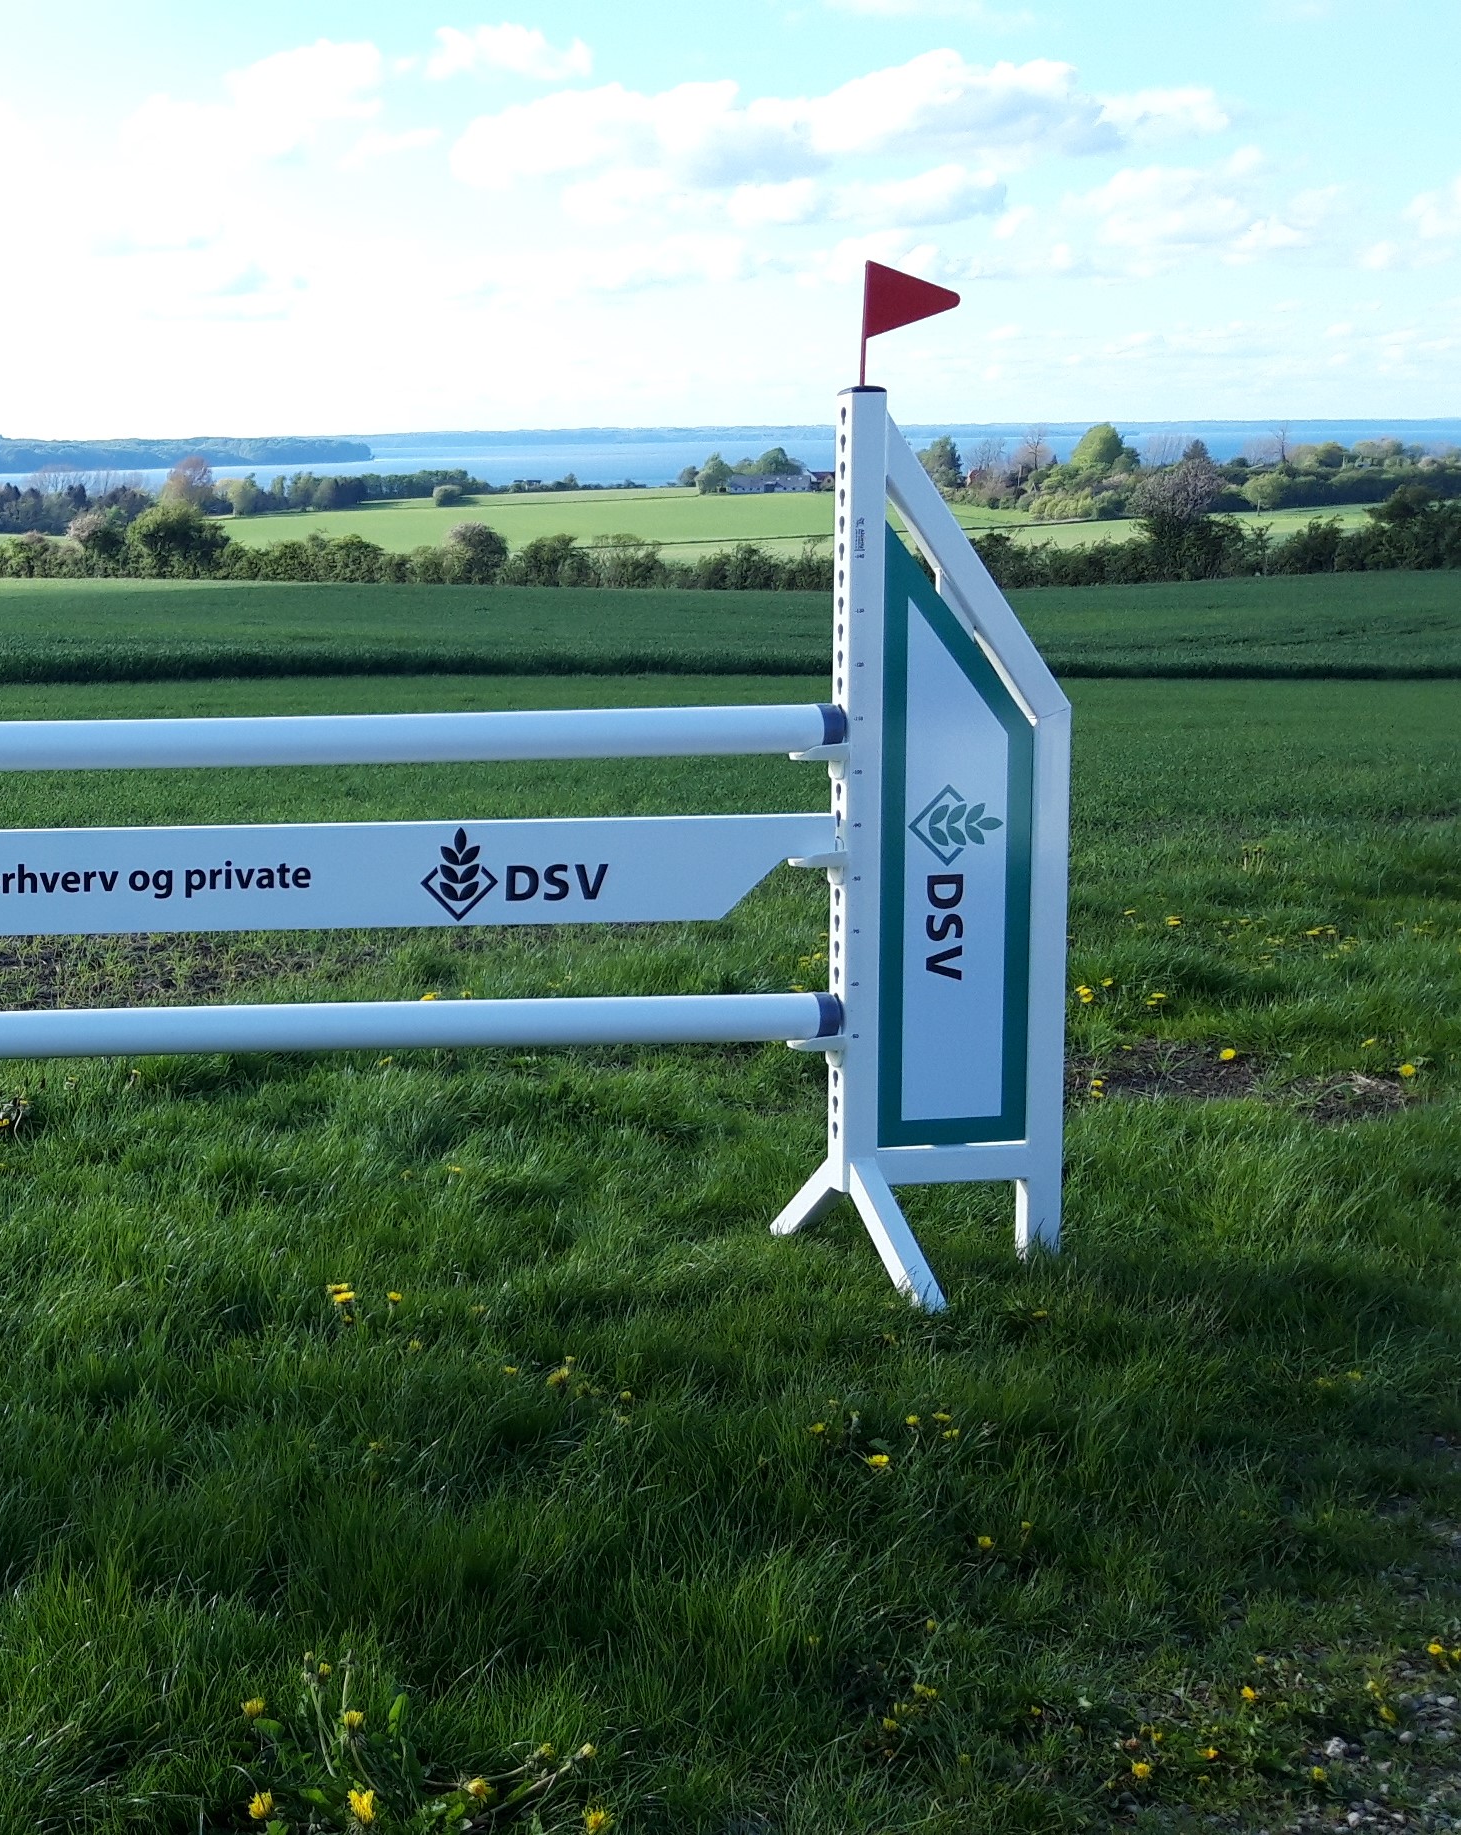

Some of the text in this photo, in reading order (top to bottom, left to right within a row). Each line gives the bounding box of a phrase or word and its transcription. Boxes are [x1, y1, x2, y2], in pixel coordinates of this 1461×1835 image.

[128, 869, 174, 900] og
[184, 860, 312, 899] private
[505, 863, 610, 902] DSV
[925, 873, 964, 982] DSV
